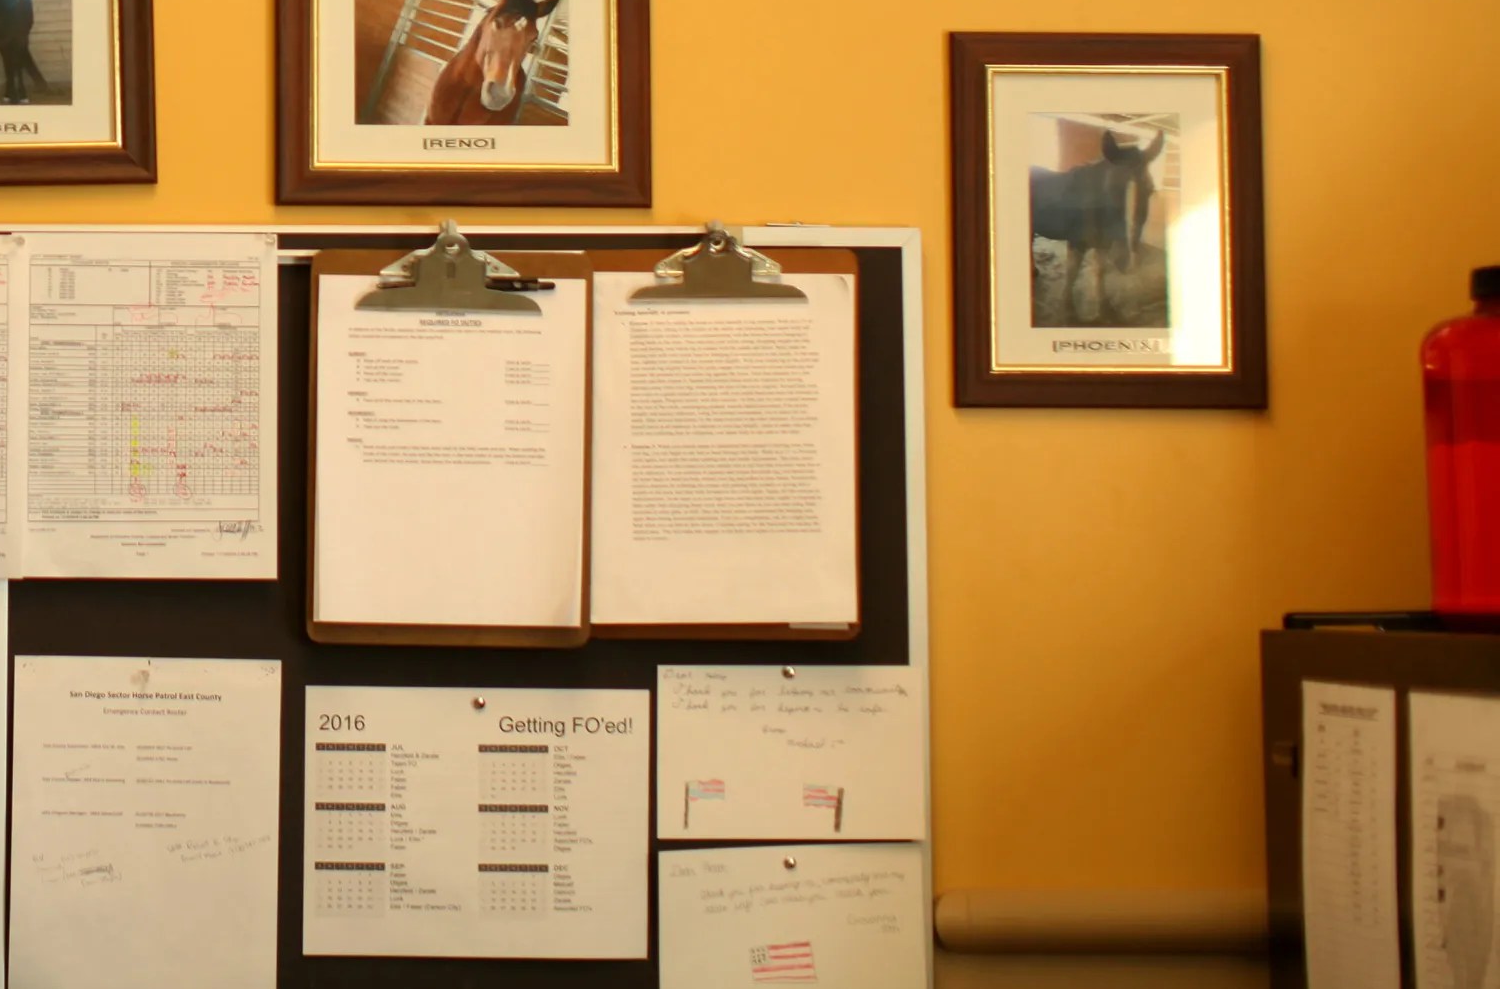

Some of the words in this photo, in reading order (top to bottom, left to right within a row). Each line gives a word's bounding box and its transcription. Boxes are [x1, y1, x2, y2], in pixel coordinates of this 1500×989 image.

[85, 691, 106, 700] Diego
[155, 692, 177, 700] Patrol
[179, 692, 194, 700] East
[196, 693, 222, 701] County
[318, 714, 366, 731] 2016
[498, 716, 565, 737] Getting
[571, 716, 634, 735] FO'ed!
